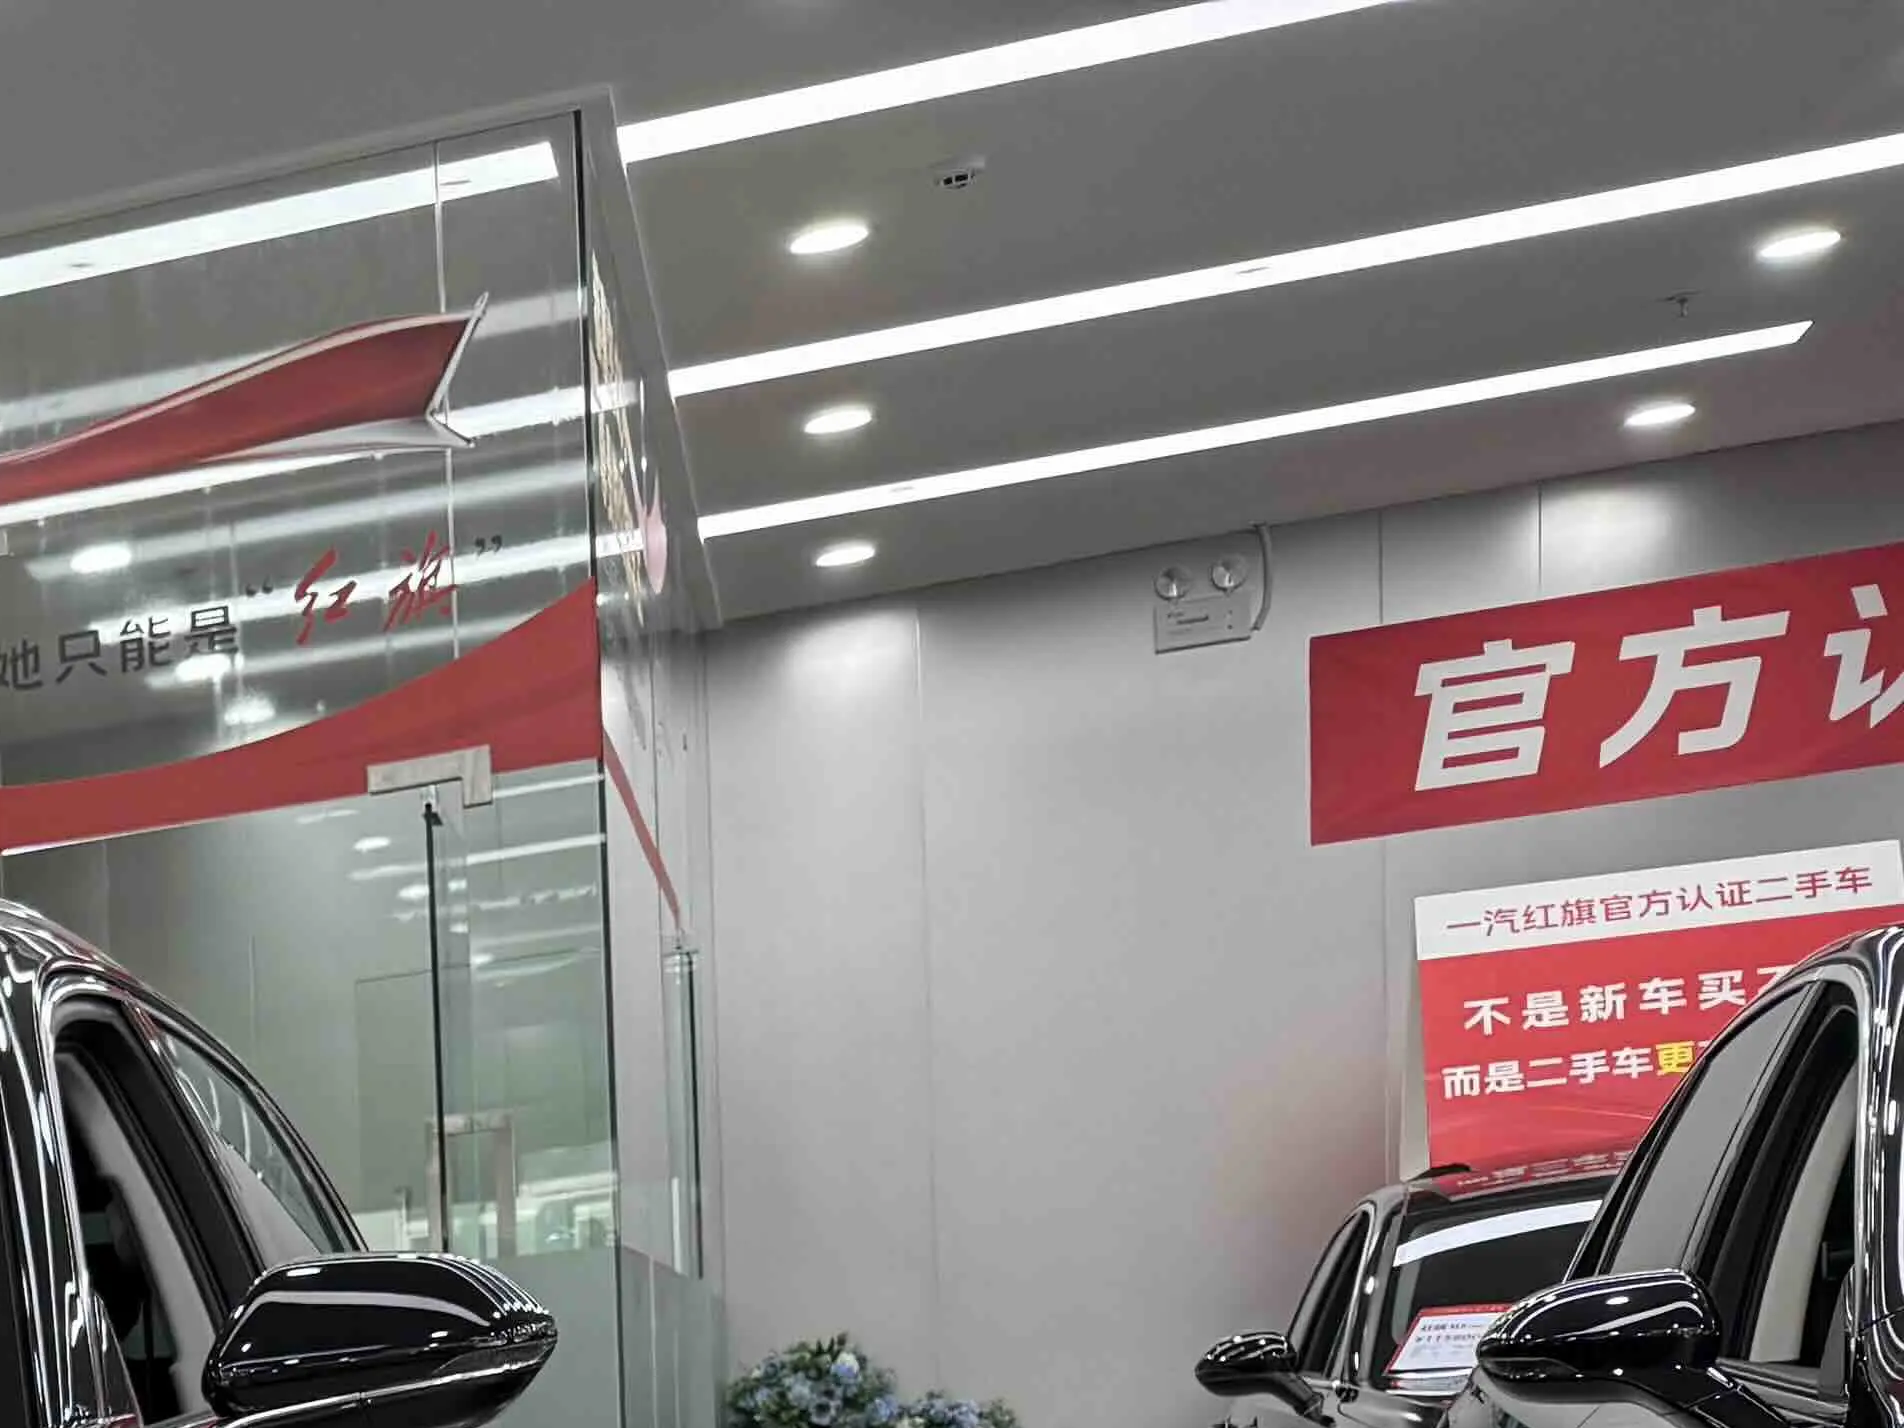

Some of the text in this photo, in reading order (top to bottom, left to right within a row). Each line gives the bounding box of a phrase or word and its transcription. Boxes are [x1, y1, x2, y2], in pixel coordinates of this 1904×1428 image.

[1445, 864, 1874, 937] 一汽红旗官方认证二手车
[1440, 1039, 1712, 1099] 而是二手车更
